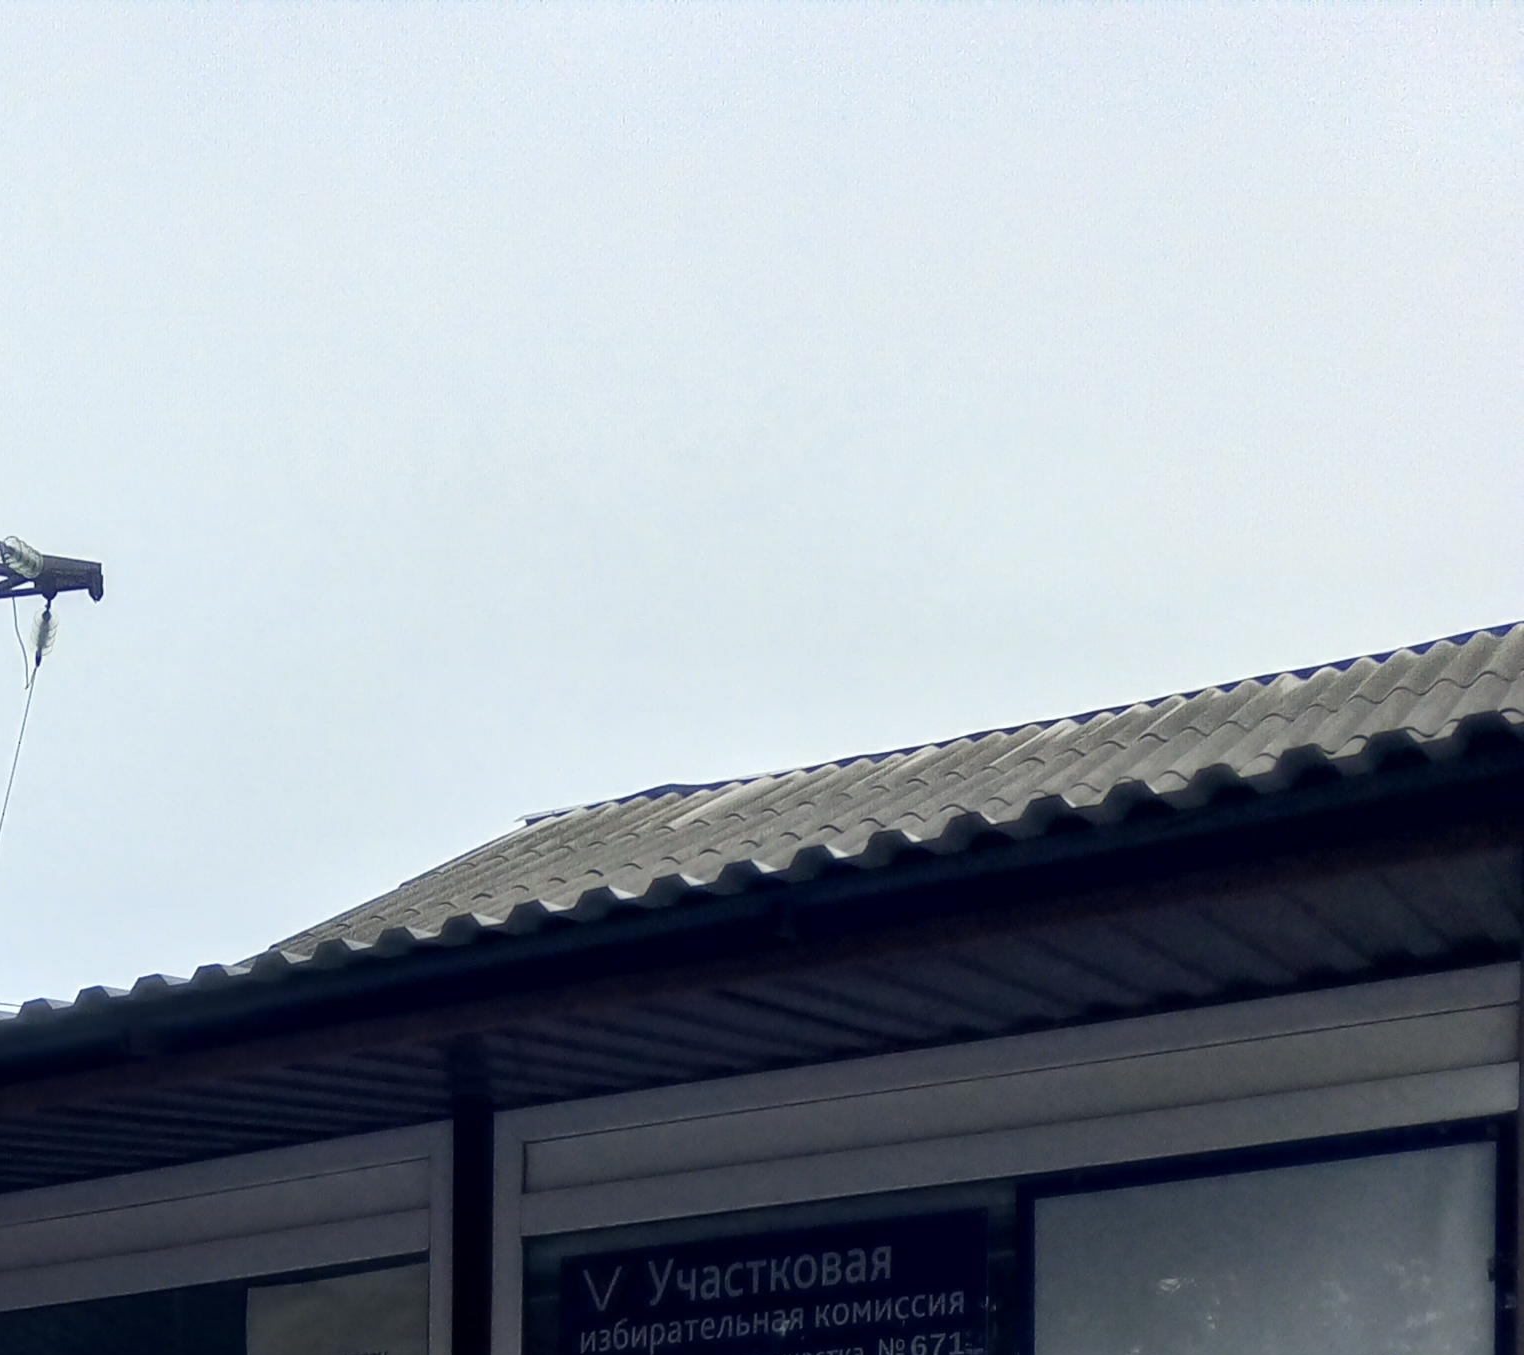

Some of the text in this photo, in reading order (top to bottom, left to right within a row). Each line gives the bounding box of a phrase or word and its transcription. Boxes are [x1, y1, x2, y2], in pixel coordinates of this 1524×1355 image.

[649, 1245, 893, 1306] Участковая
[580, 1290, 965, 1355] избирательная комиссия
